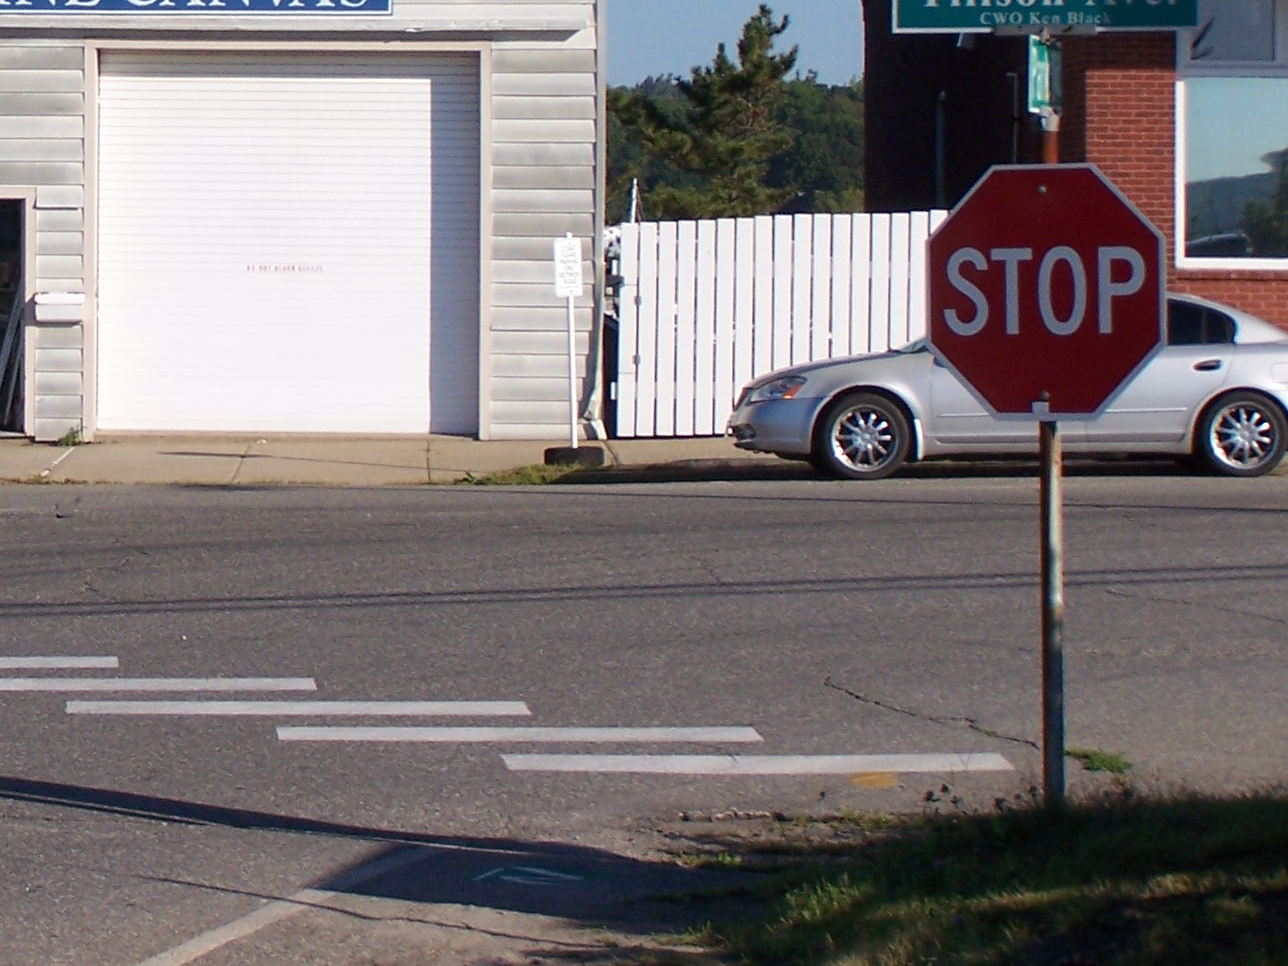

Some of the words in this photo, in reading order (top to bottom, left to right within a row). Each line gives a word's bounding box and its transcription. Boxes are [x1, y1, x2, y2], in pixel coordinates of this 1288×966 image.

[979, 11, 1024, 25] CWO
[1029, 11, 1061, 24] Ken
[1067, 10, 1111, 24] Black
[942, 245, 1147, 337] STOP
